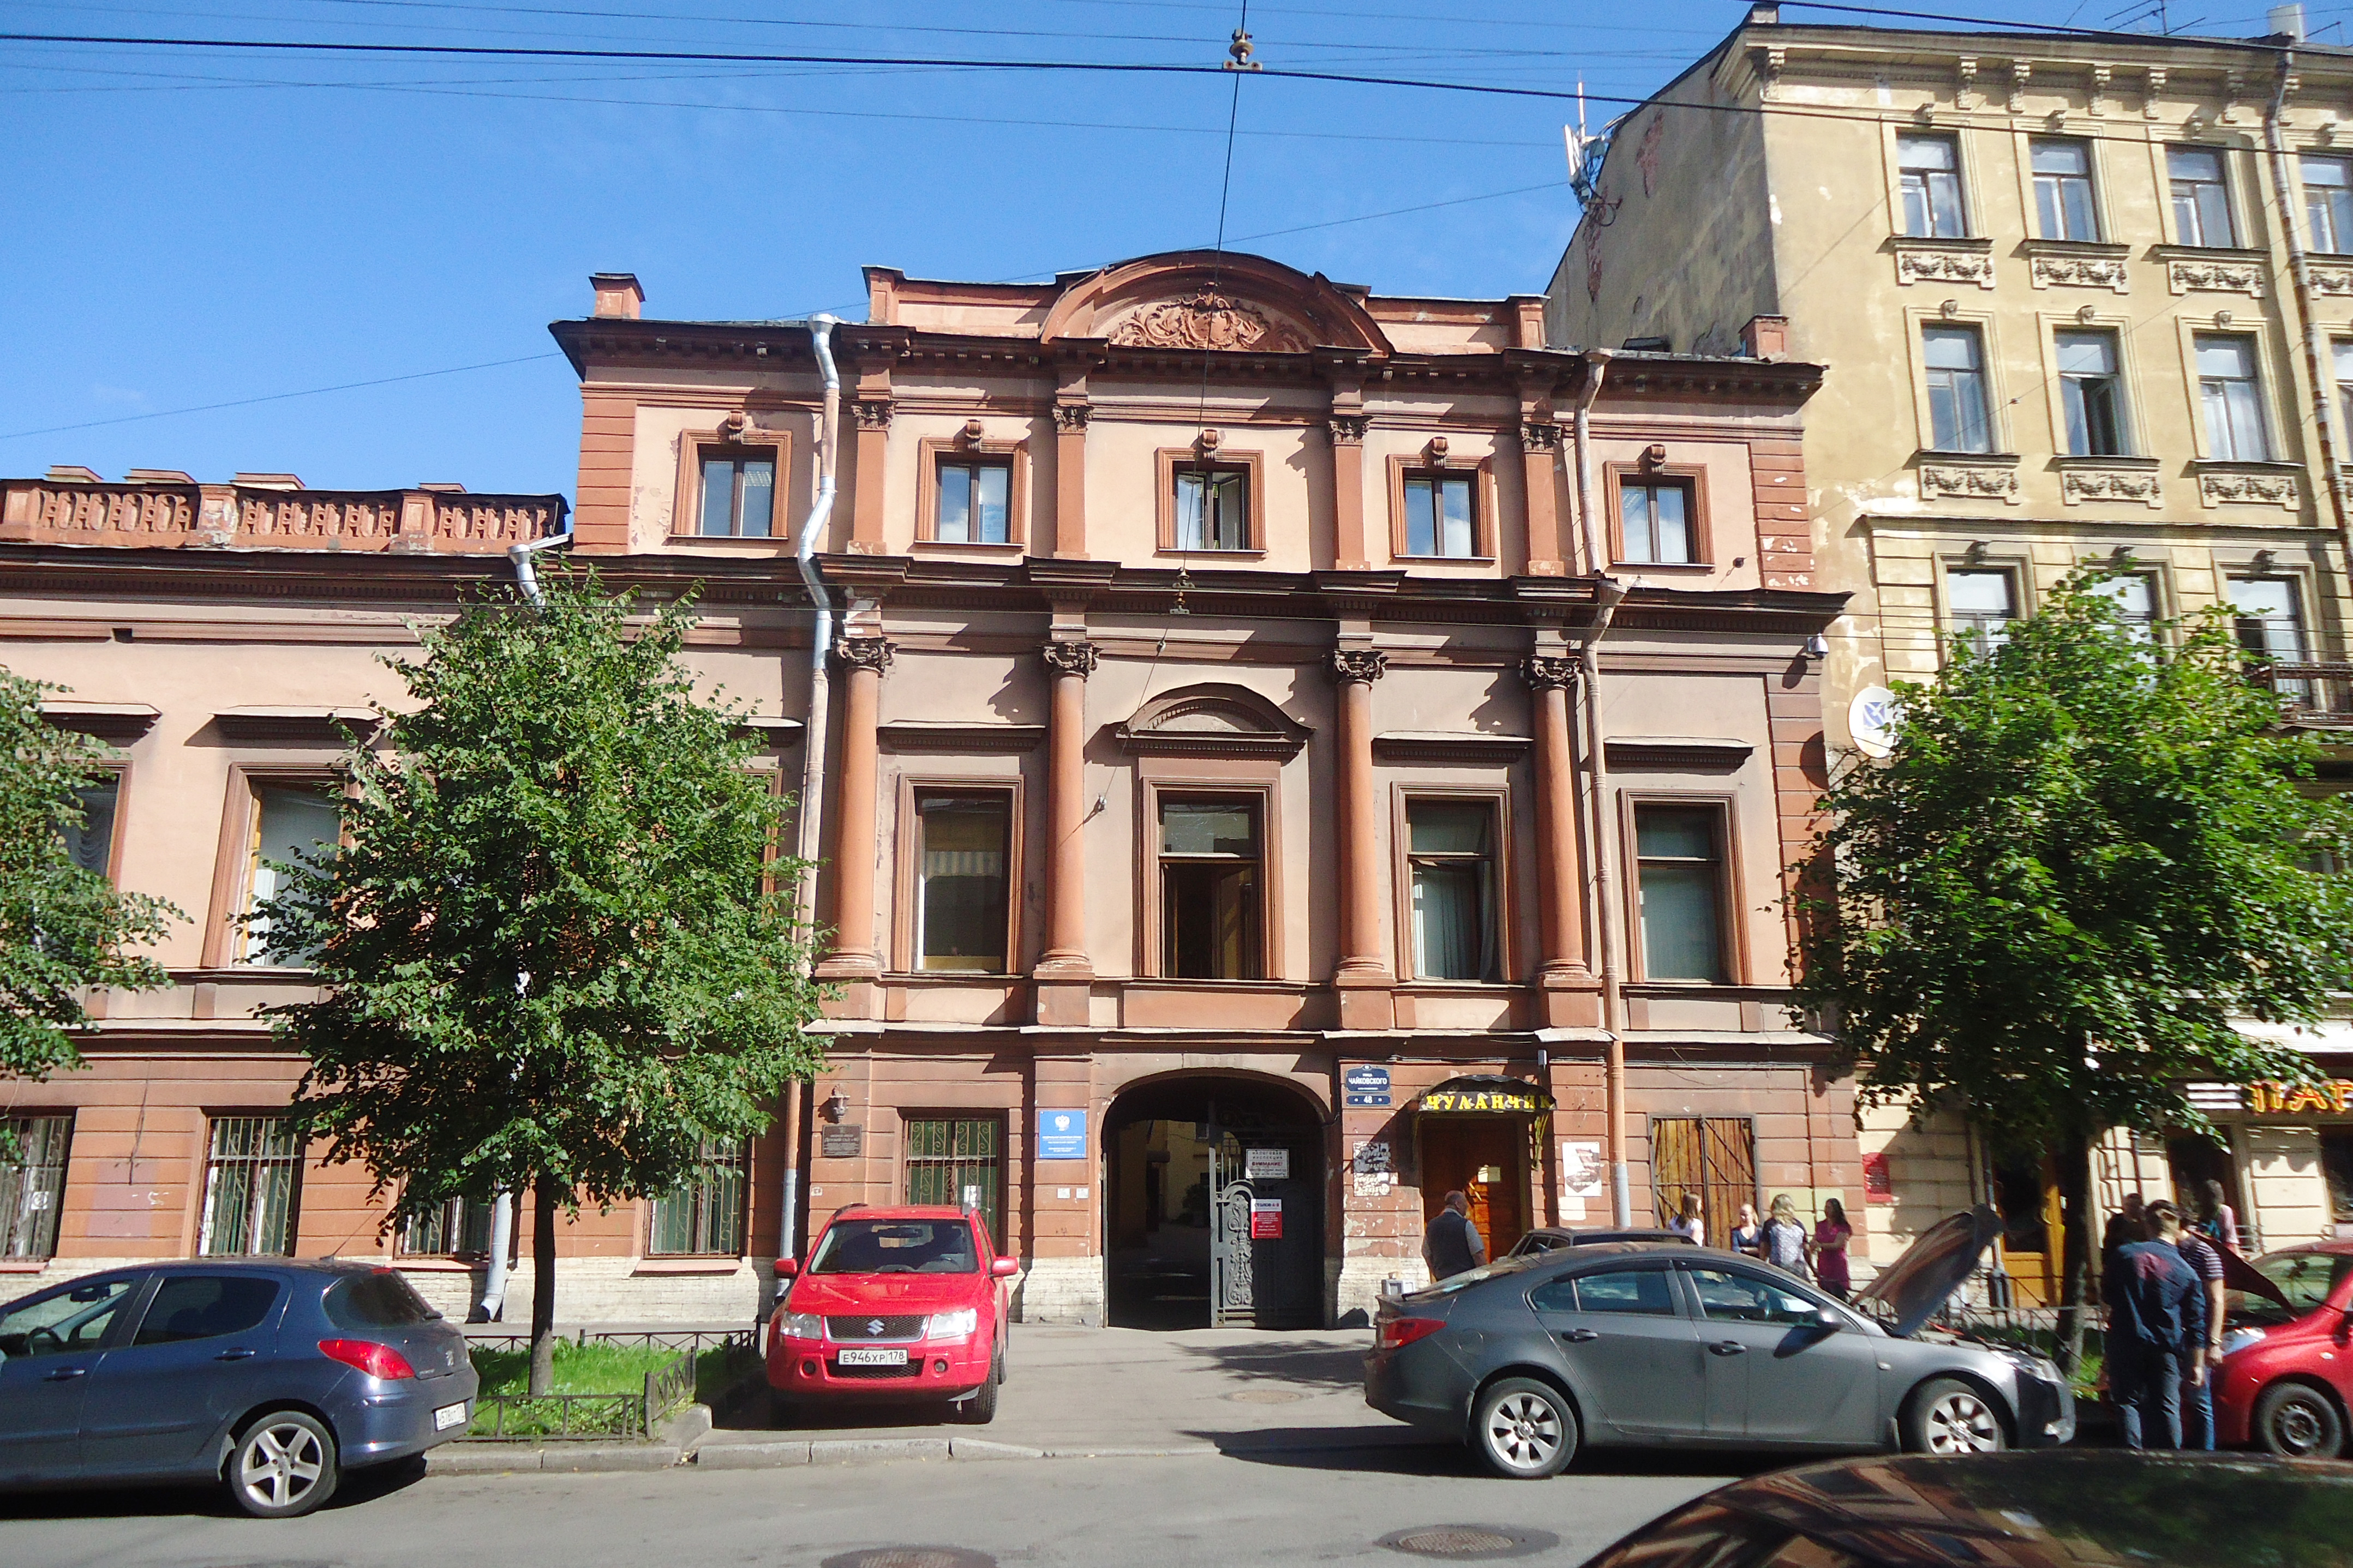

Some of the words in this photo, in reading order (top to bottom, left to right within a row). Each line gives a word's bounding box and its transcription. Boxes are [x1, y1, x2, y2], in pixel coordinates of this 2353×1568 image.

[1348, 1077, 1387, 1085] ЧАЙКОВСКОГО
[1364, 1096, 1373, 1104] 48
[1426, 1095, 1552, 1110] ЧУЛАНЧИК
[889, 1351, 904, 1360] 178
